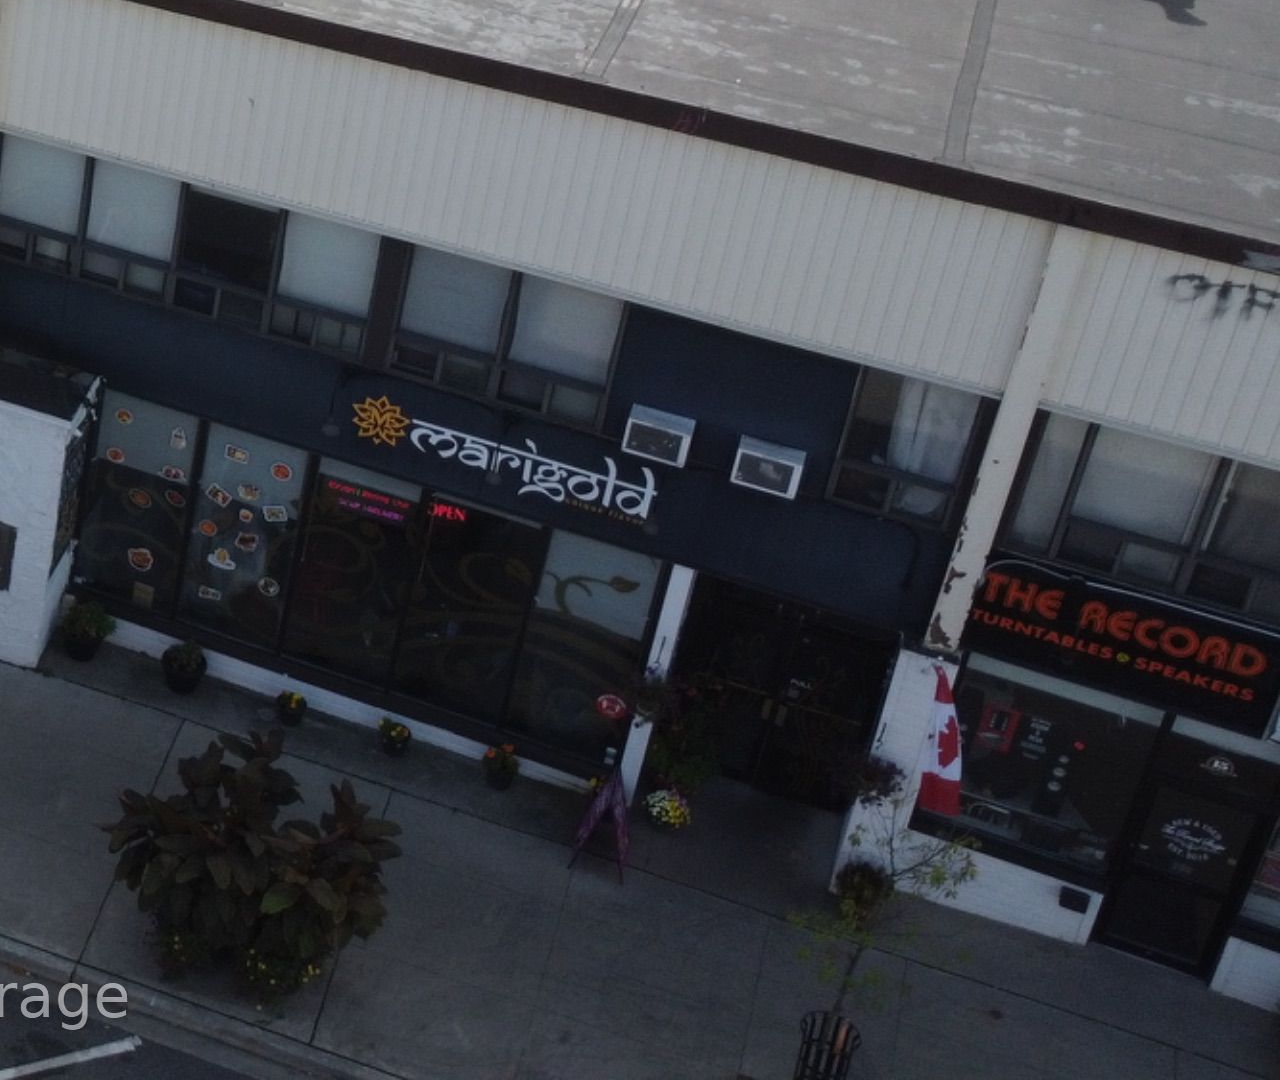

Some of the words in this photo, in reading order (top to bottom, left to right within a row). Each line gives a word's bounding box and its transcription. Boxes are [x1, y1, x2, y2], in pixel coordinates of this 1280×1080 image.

[409, 417, 659, 520] marigold
[428, 502, 467, 522] OPEN
[971, 607, 1114, 660] TURNTABLES
[1133, 656, 1257, 703] SPEAKERS
[984, 570, 1065, 621] THE
[1079, 599, 1270, 678] RECORD
